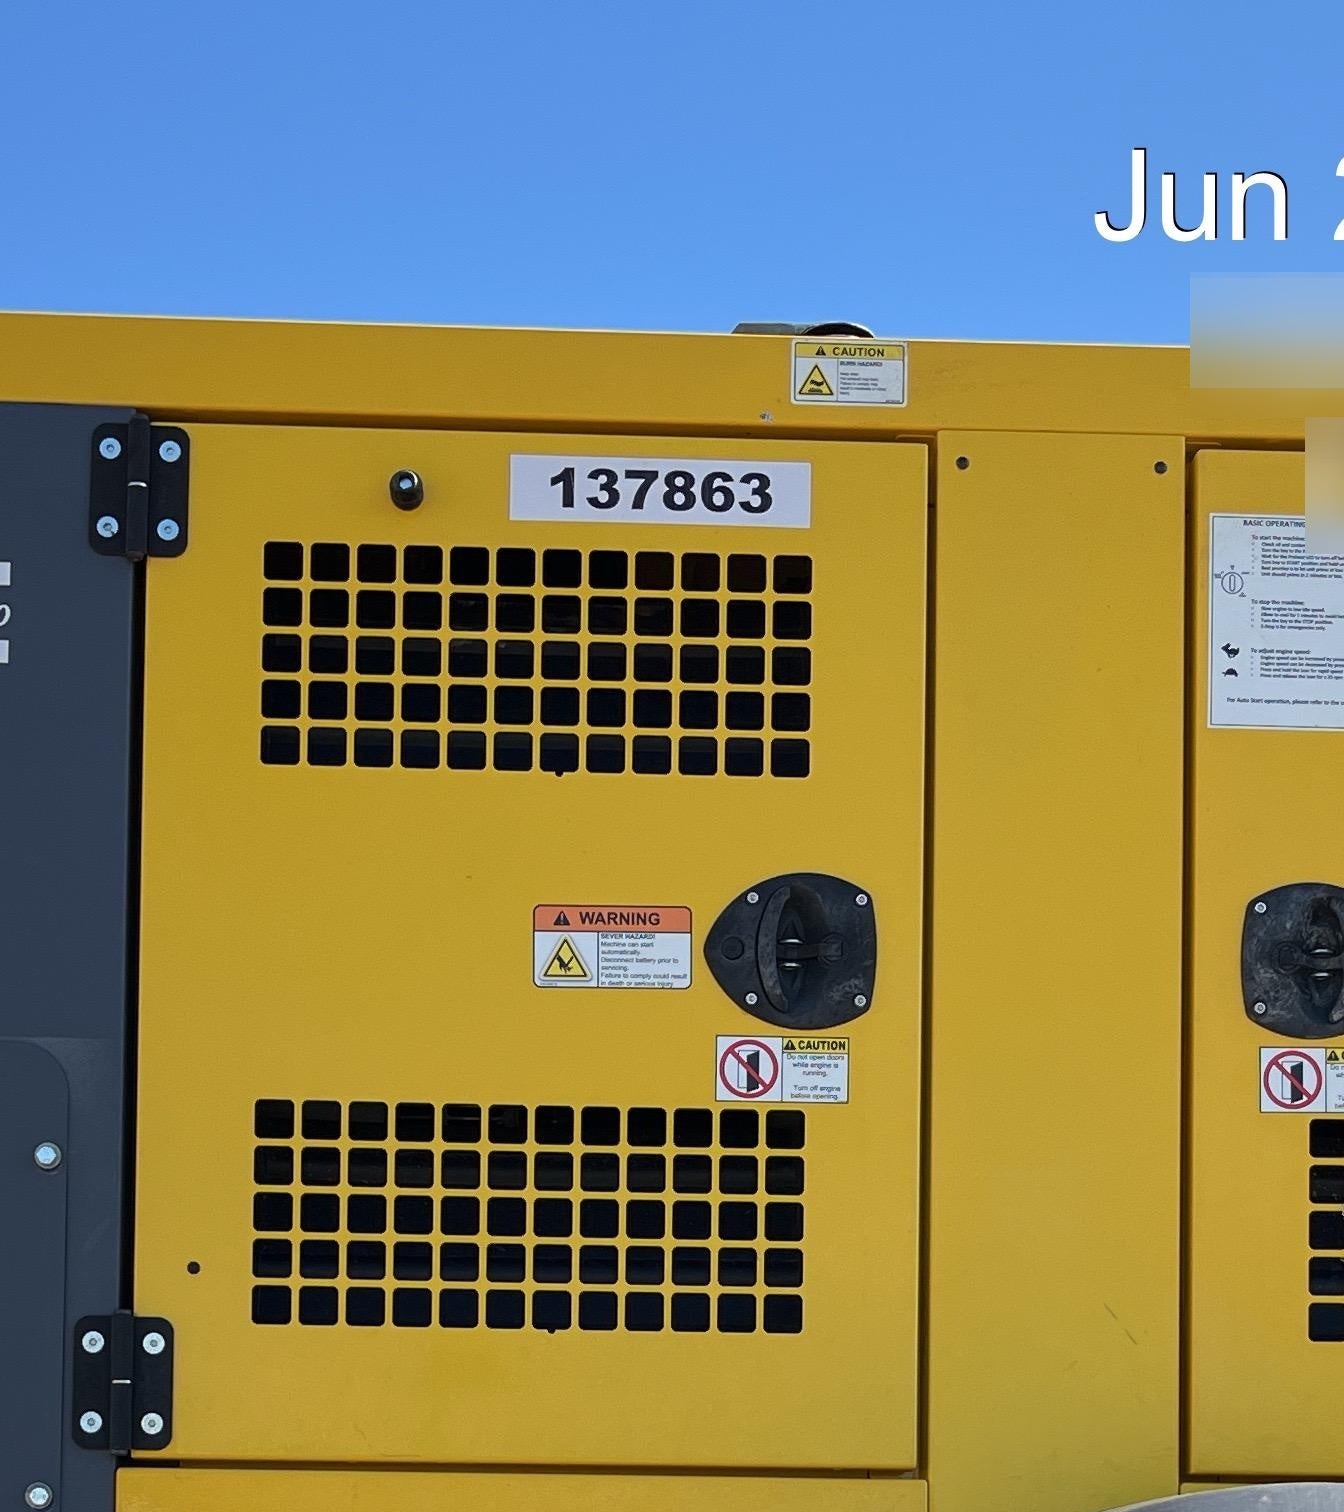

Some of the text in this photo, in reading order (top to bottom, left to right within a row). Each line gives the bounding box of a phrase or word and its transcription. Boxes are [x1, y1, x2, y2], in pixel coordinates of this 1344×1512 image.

[832, 347, 884, 357] CAUTION
[550, 467, 773, 514] 137863
[579, 912, 660, 925] WARNING
[798, 1041, 846, 1050] CAUTION
